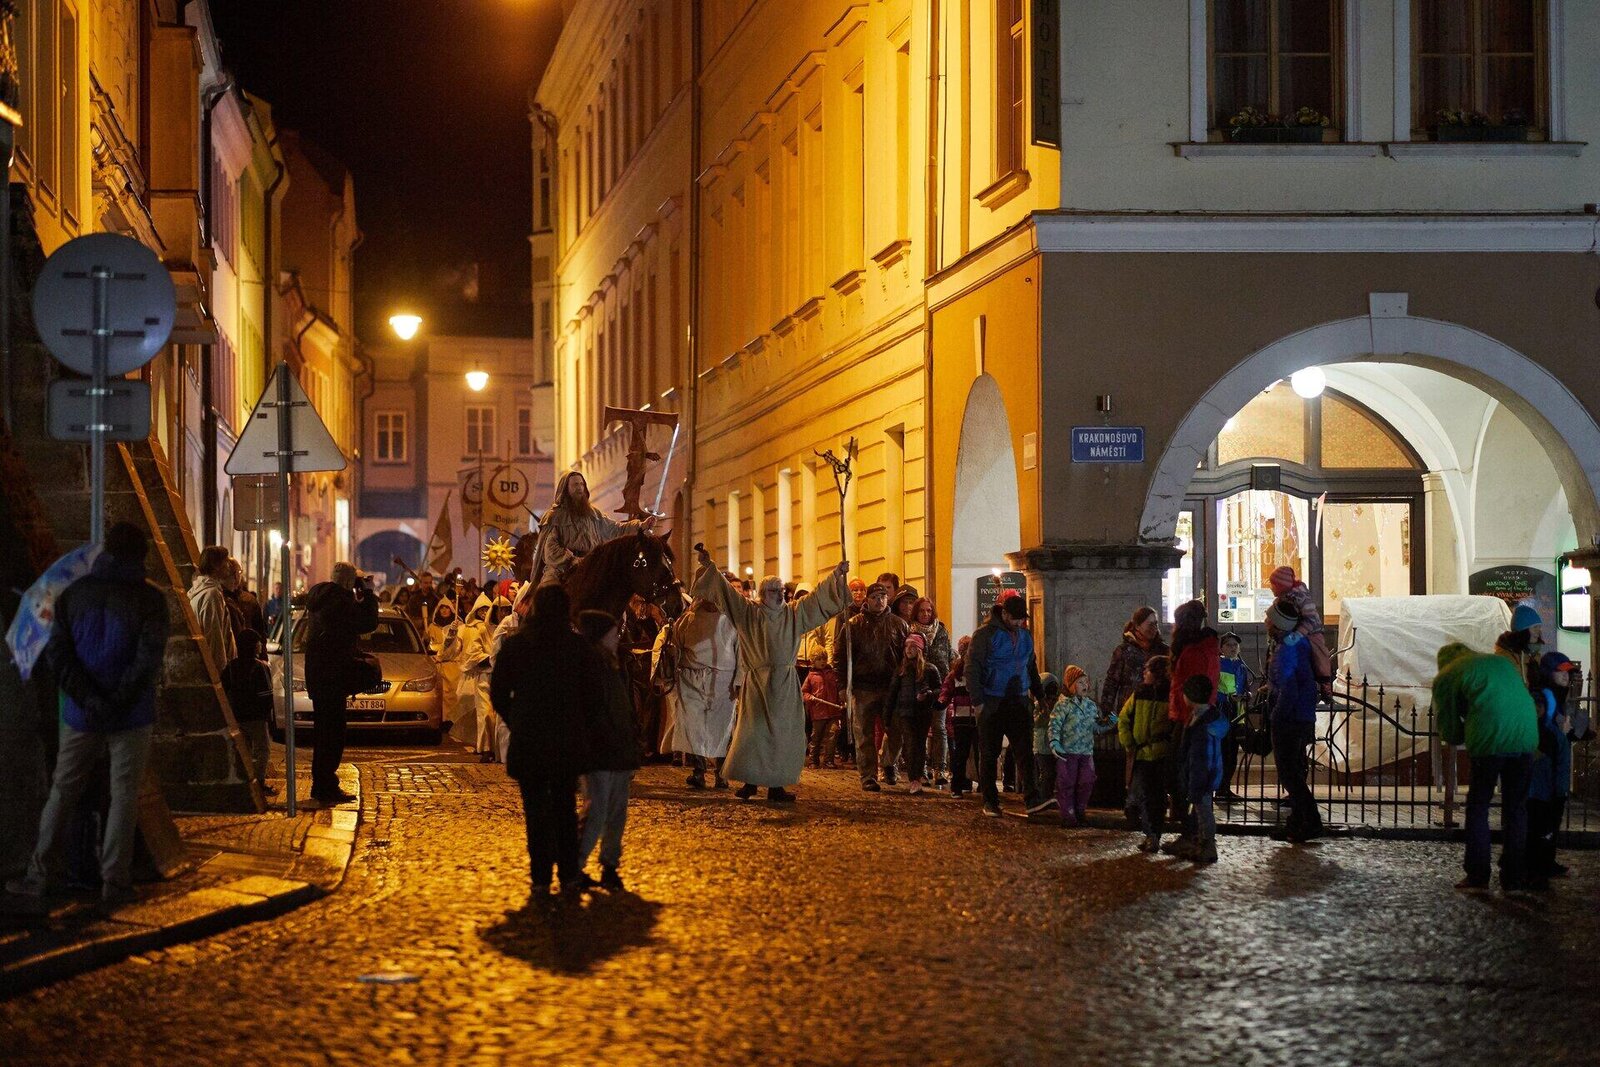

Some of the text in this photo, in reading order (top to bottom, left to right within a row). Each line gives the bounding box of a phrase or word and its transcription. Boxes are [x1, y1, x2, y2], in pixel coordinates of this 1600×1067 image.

[1078, 431, 1137, 443] KRAKONOŠOVO
[1090, 445, 1126, 457] NÁMĚSTÍ
[500, 480, 519, 493] DB
[360, 700, 369, 708] ST
